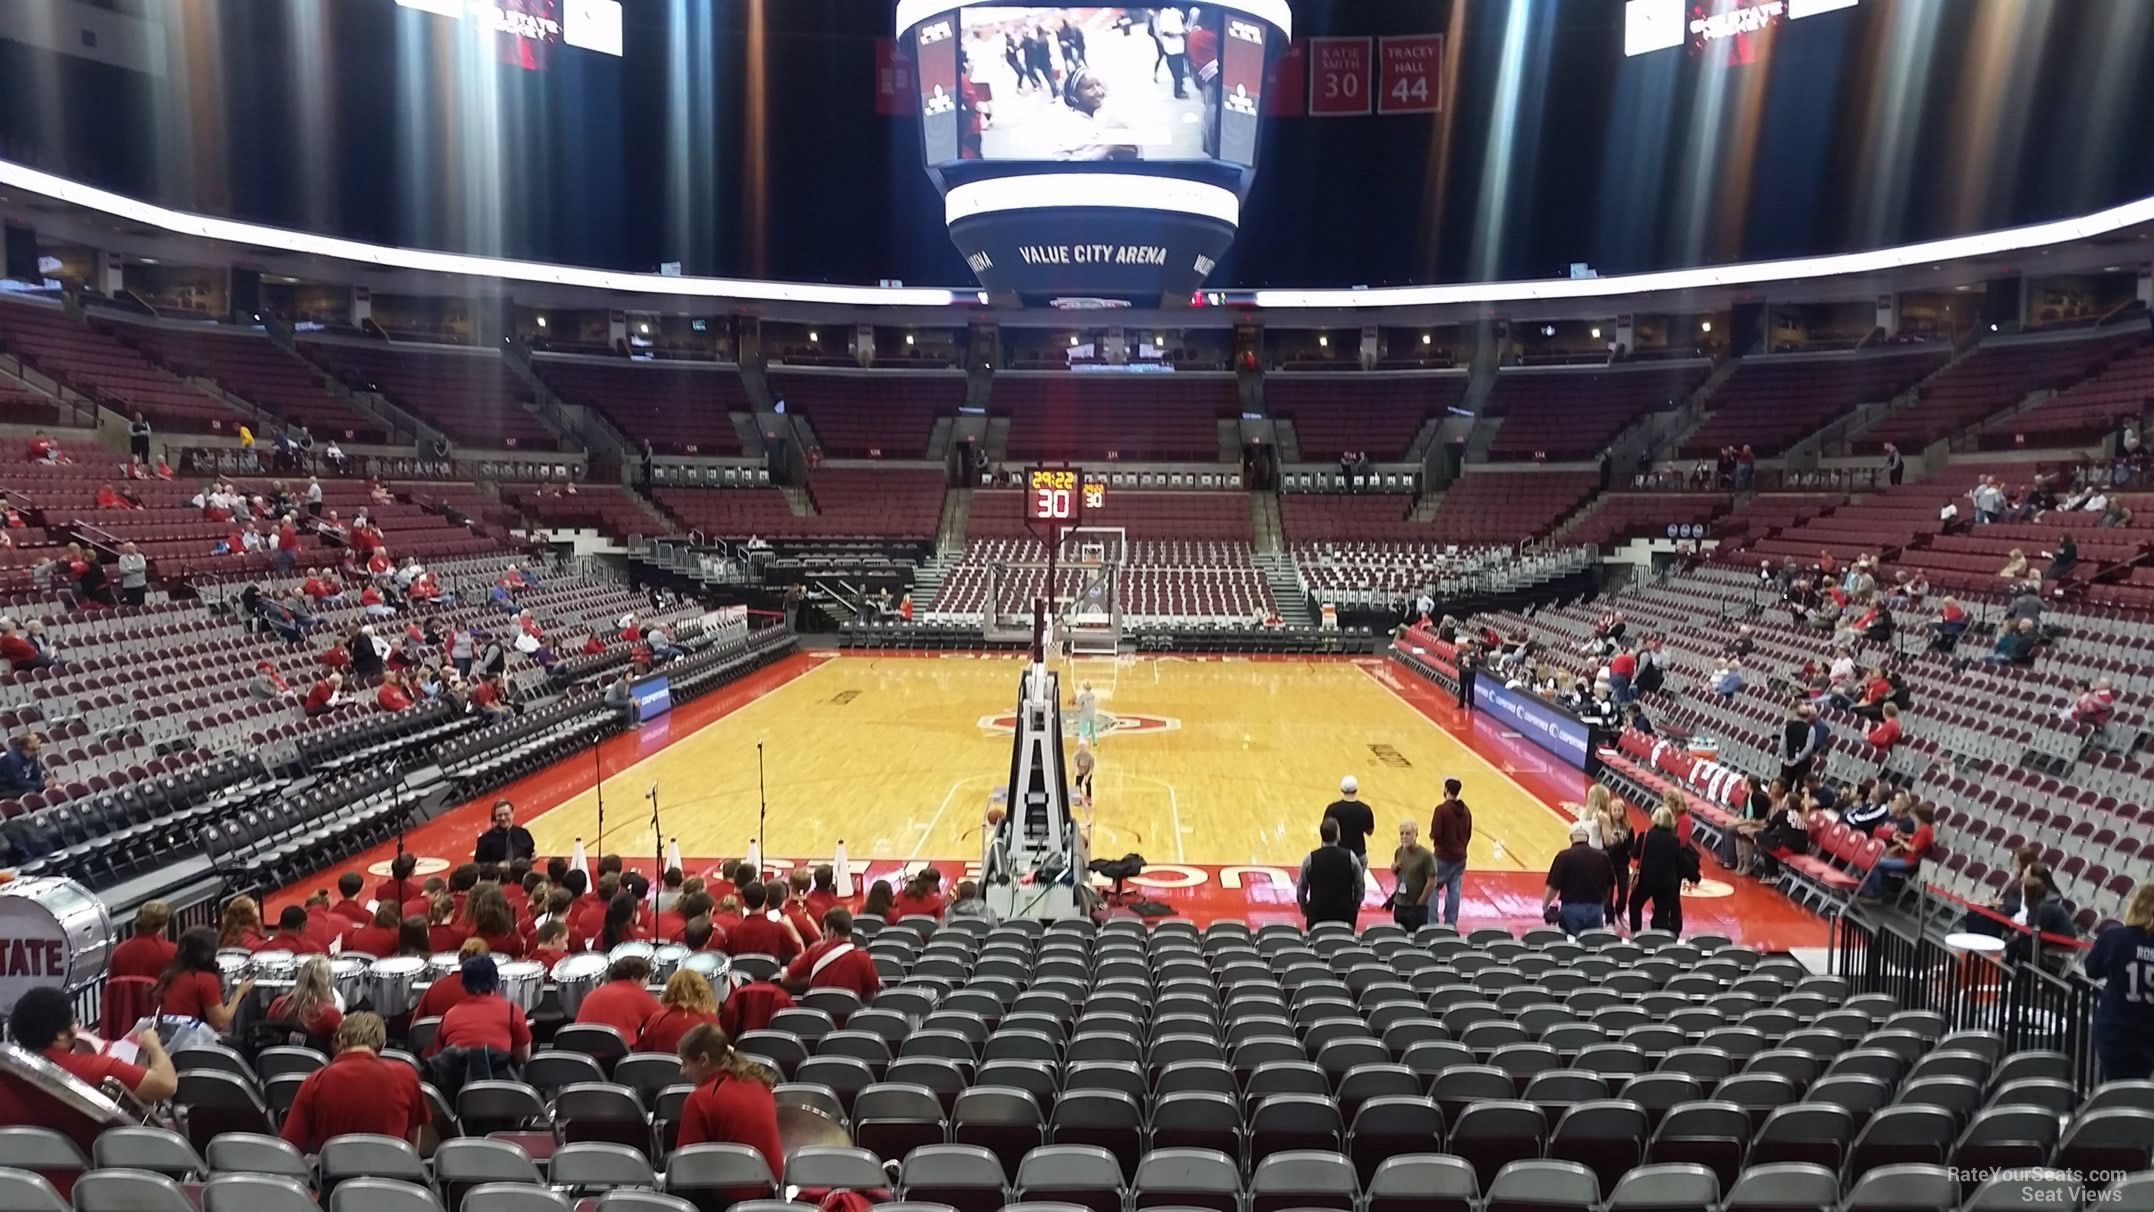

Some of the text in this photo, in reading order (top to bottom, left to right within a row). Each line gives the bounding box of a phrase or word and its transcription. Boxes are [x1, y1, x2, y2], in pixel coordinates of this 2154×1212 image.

[1322, 48, 1360, 59] KATIE
[1386, 46, 1435, 58] TRACEY
[1322, 59, 1360, 70] SMITH
[1395, 62, 1424, 73] HALL
[1324, 73, 1358, 98] 30
[1392, 77, 1429, 102] 44
[1018, 244, 1168, 267] VALUE CITY ARENA
[1032, 471, 1075, 490] 29:22
[1038, 489, 1069, 518] 30
[1086, 493, 1103, 508] 30
